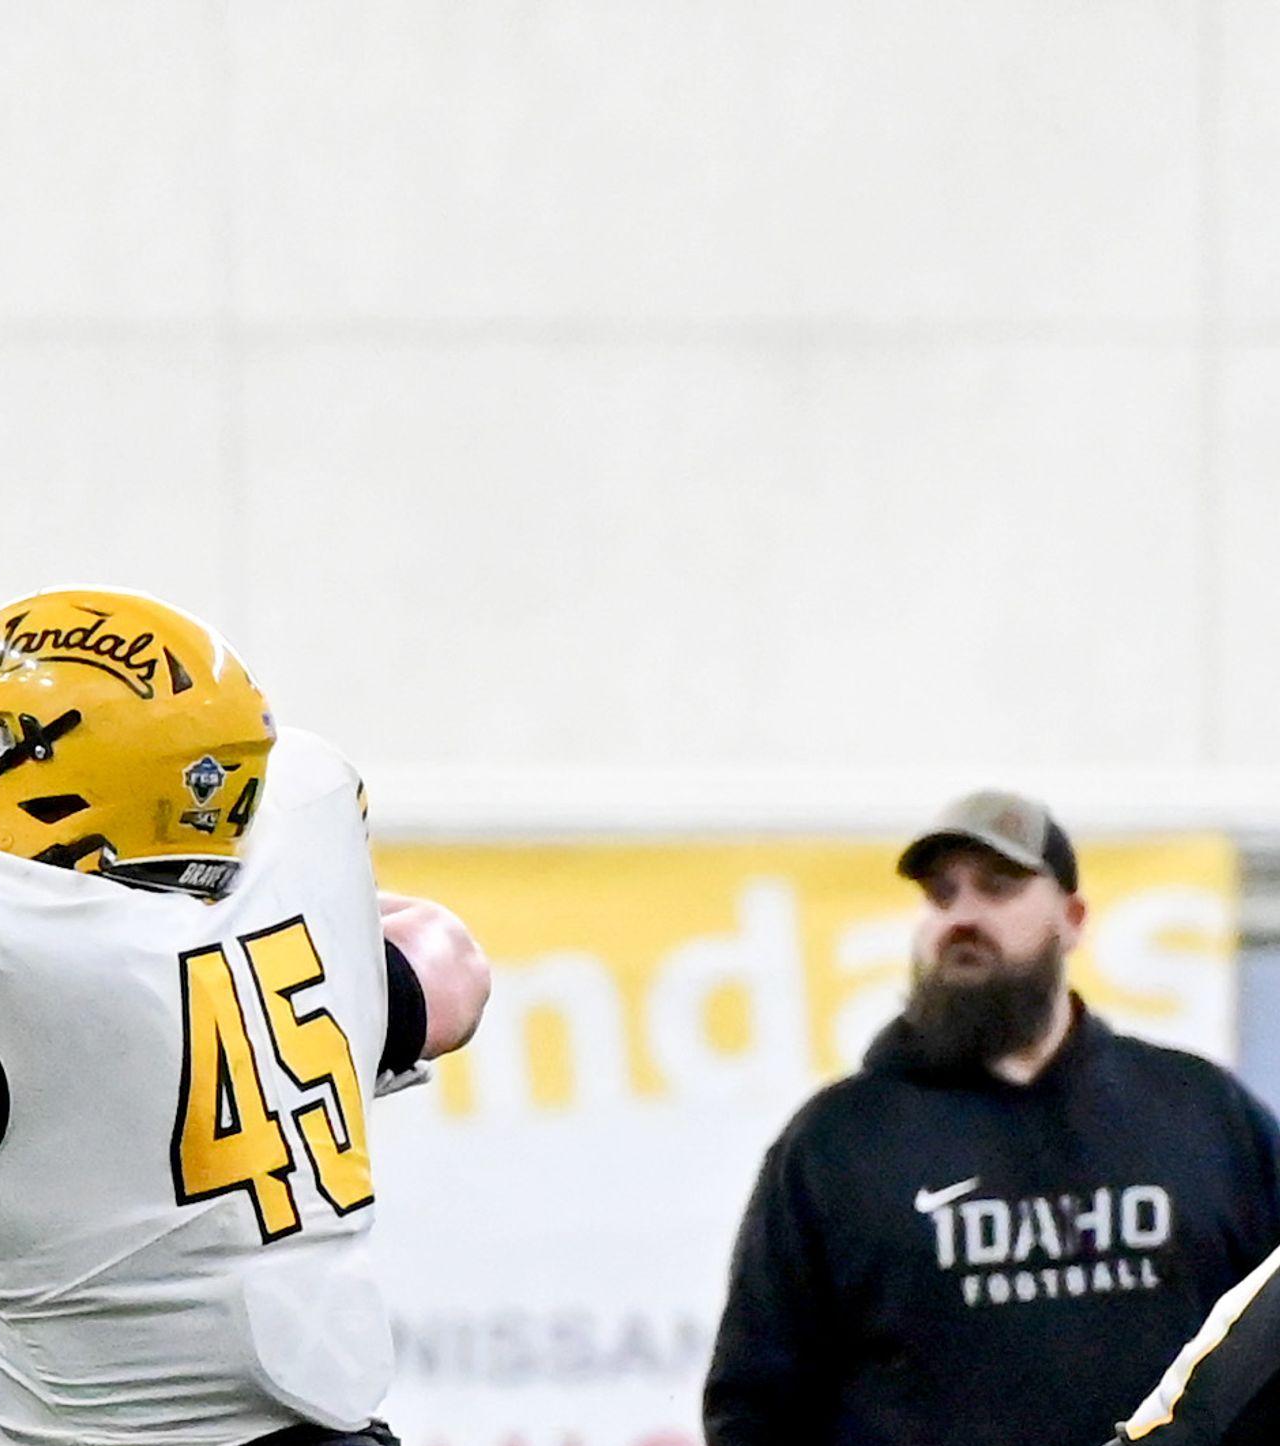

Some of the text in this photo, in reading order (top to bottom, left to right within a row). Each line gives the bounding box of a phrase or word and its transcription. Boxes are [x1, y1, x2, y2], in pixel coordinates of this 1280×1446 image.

[169, 914, 376, 1246] 45
[932, 1184, 1171, 1271] IDAHO
[962, 1258, 1161, 1307] FOOTBALL
